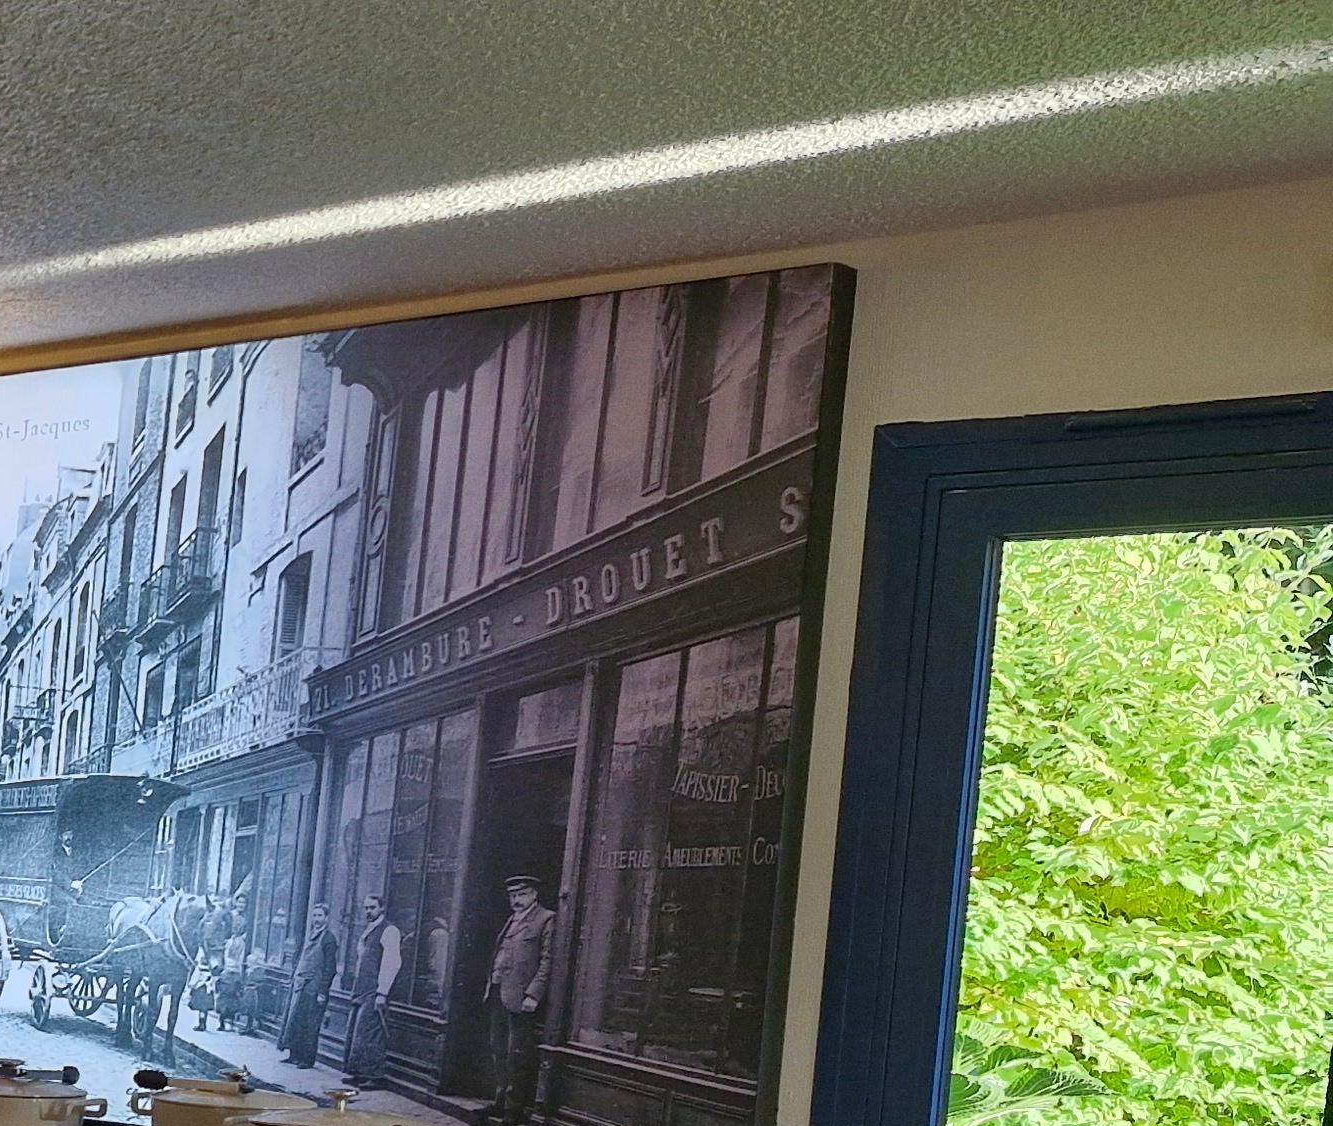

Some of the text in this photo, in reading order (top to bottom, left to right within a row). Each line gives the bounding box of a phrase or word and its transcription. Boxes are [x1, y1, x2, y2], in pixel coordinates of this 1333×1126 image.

[345, 616, 493, 700] DERAMBURE
[546, 517, 724, 625] DROUET
[780, 486, 804, 534] S
